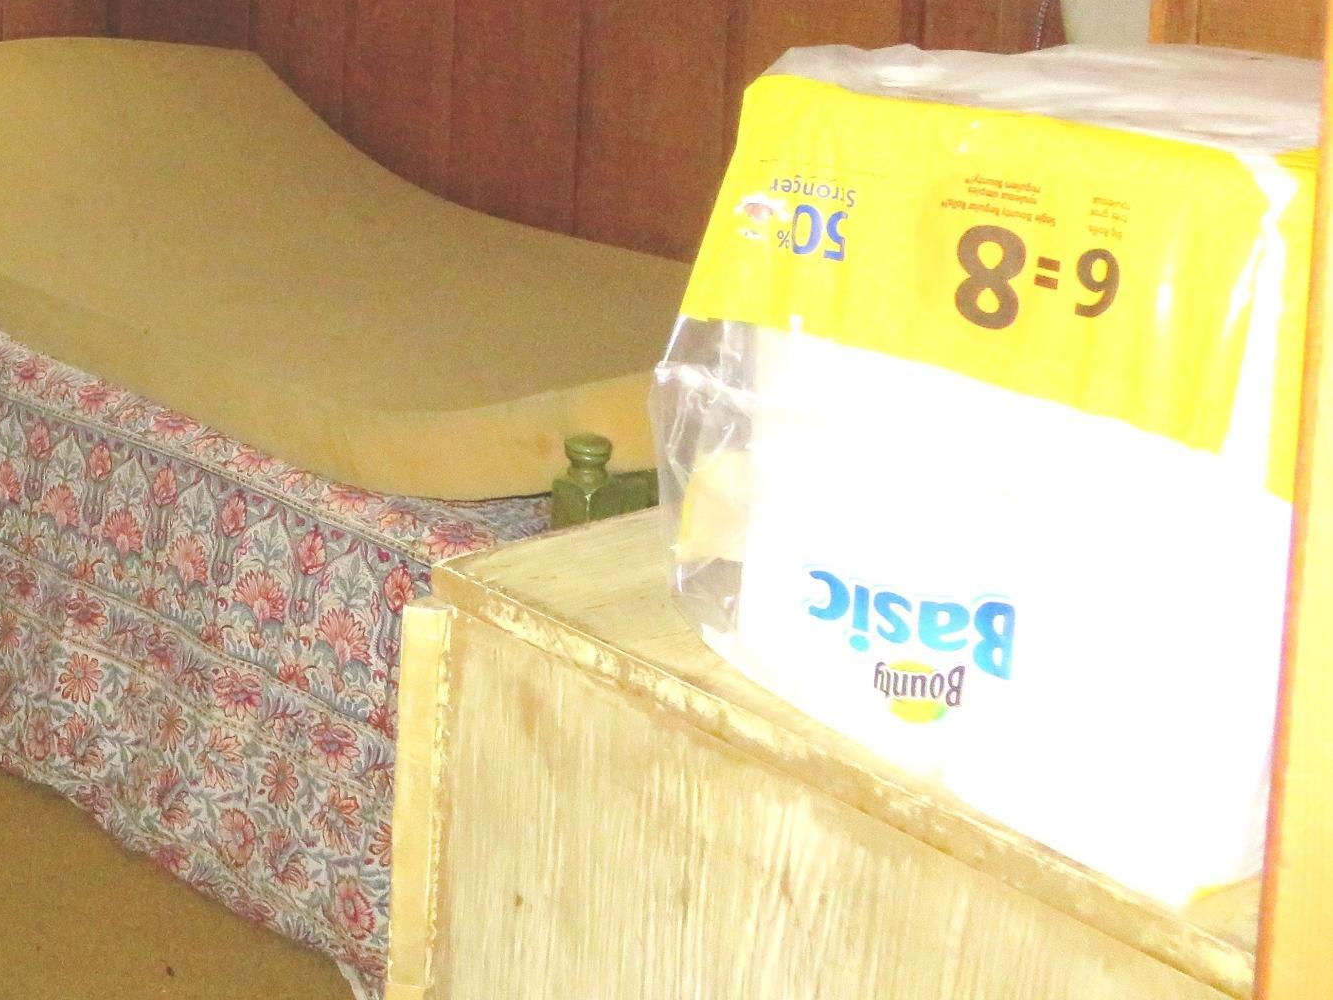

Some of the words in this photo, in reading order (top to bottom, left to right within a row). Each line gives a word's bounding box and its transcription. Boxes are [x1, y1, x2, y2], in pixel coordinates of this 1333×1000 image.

[770, 175, 856, 208] Stronger
[807, 570, 1016, 681] Basic
[873, 661, 966, 708] Bounty
